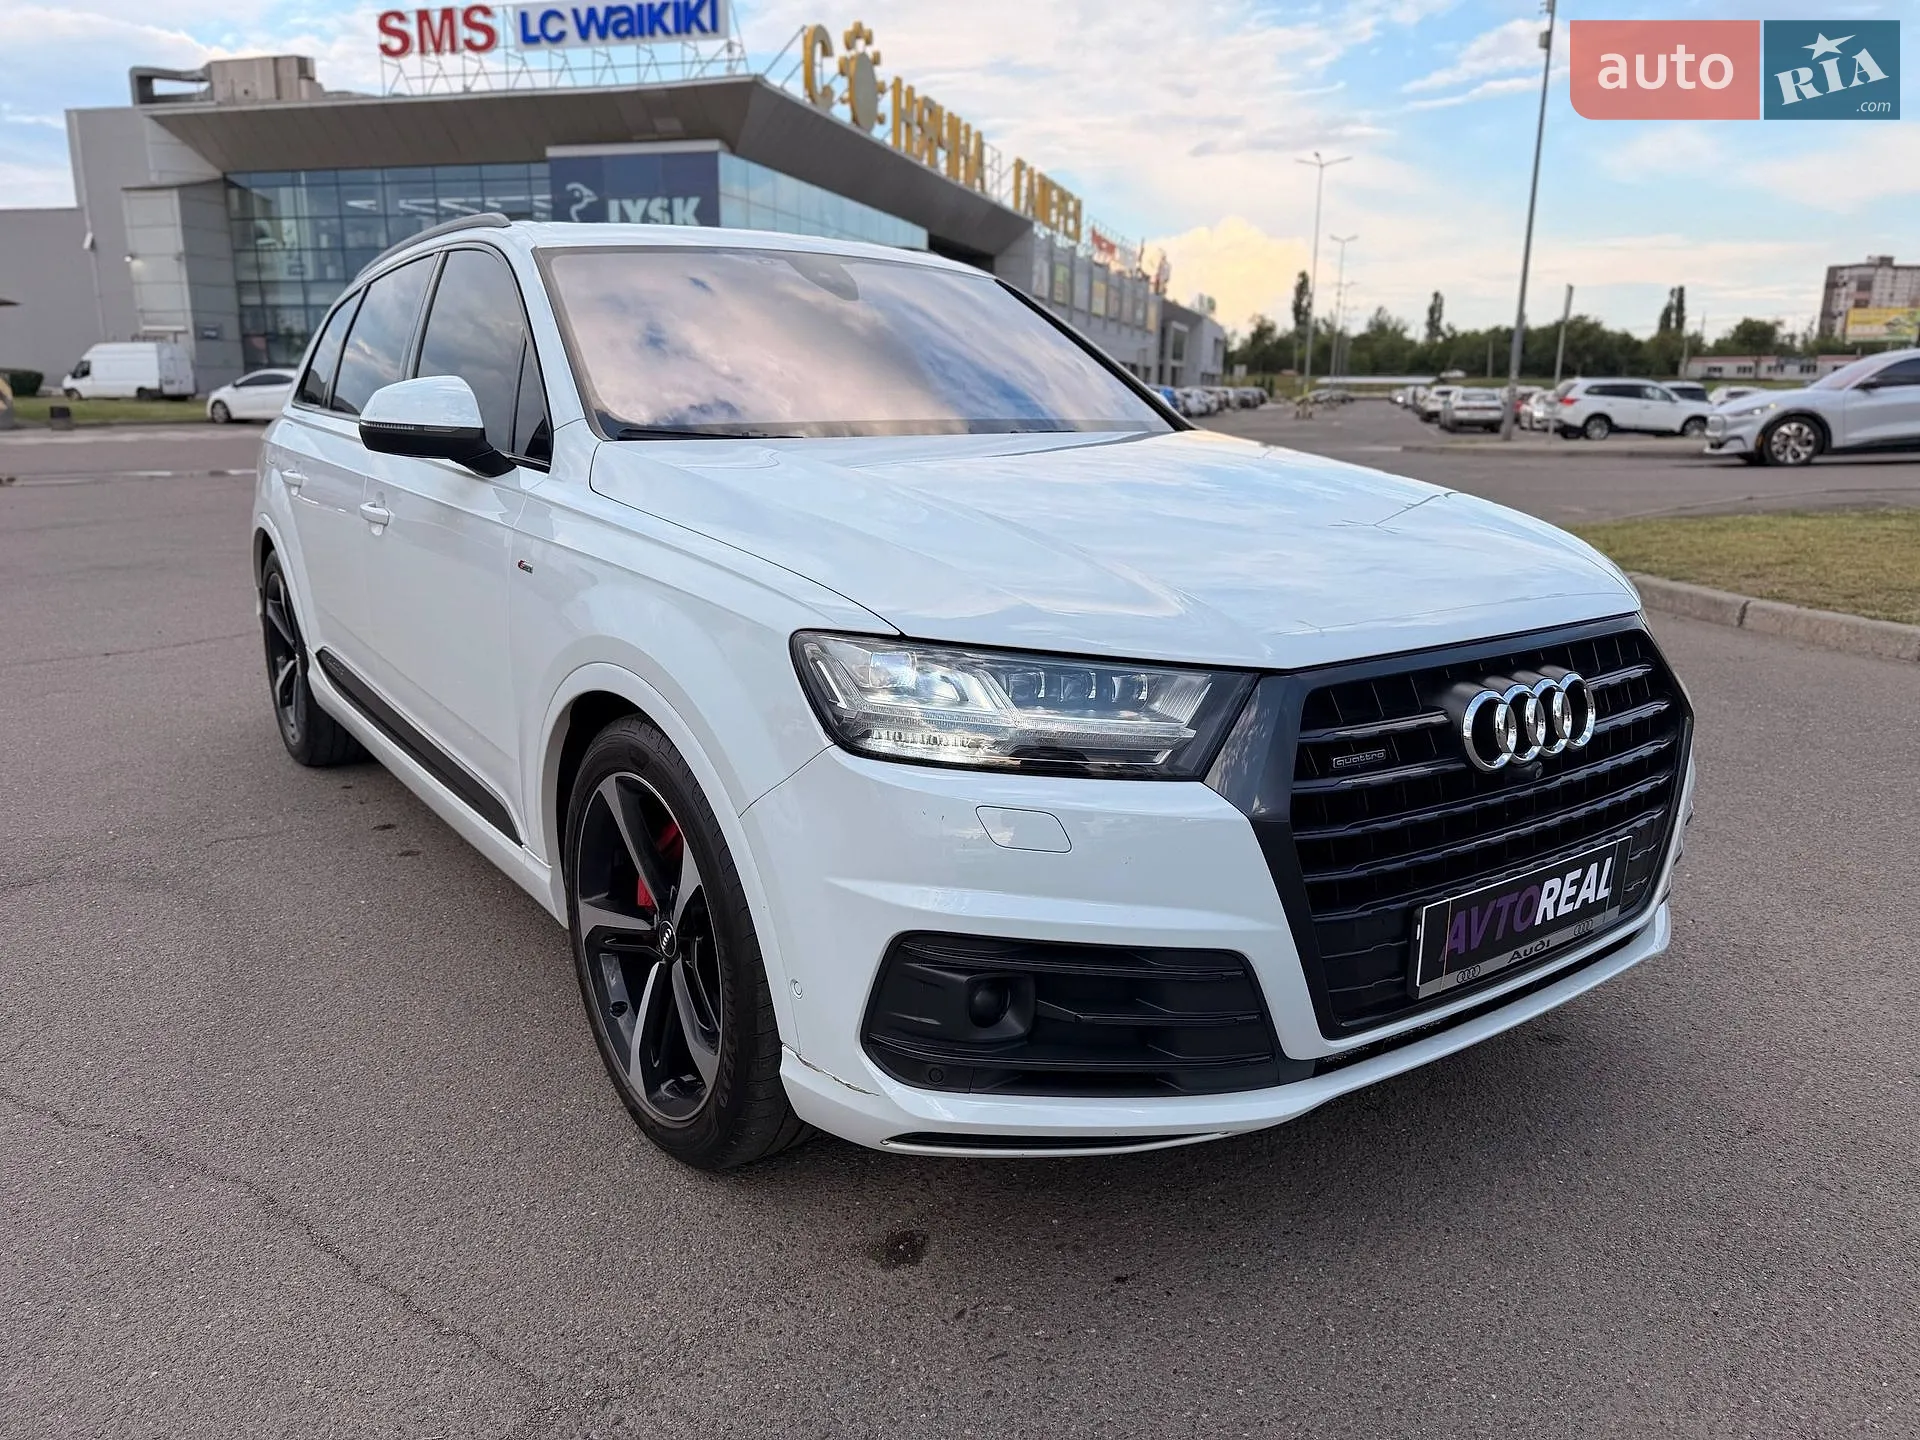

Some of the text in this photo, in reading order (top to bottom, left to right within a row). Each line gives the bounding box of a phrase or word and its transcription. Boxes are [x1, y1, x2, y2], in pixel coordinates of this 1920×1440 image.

[378, 4, 498, 58] SMS
[519, 9, 567, 45] LC
[1336, 752, 1385, 767] quattro
[1438, 856, 1613, 962] AVTOREAL
[1506, 938, 1552, 963] Audi
